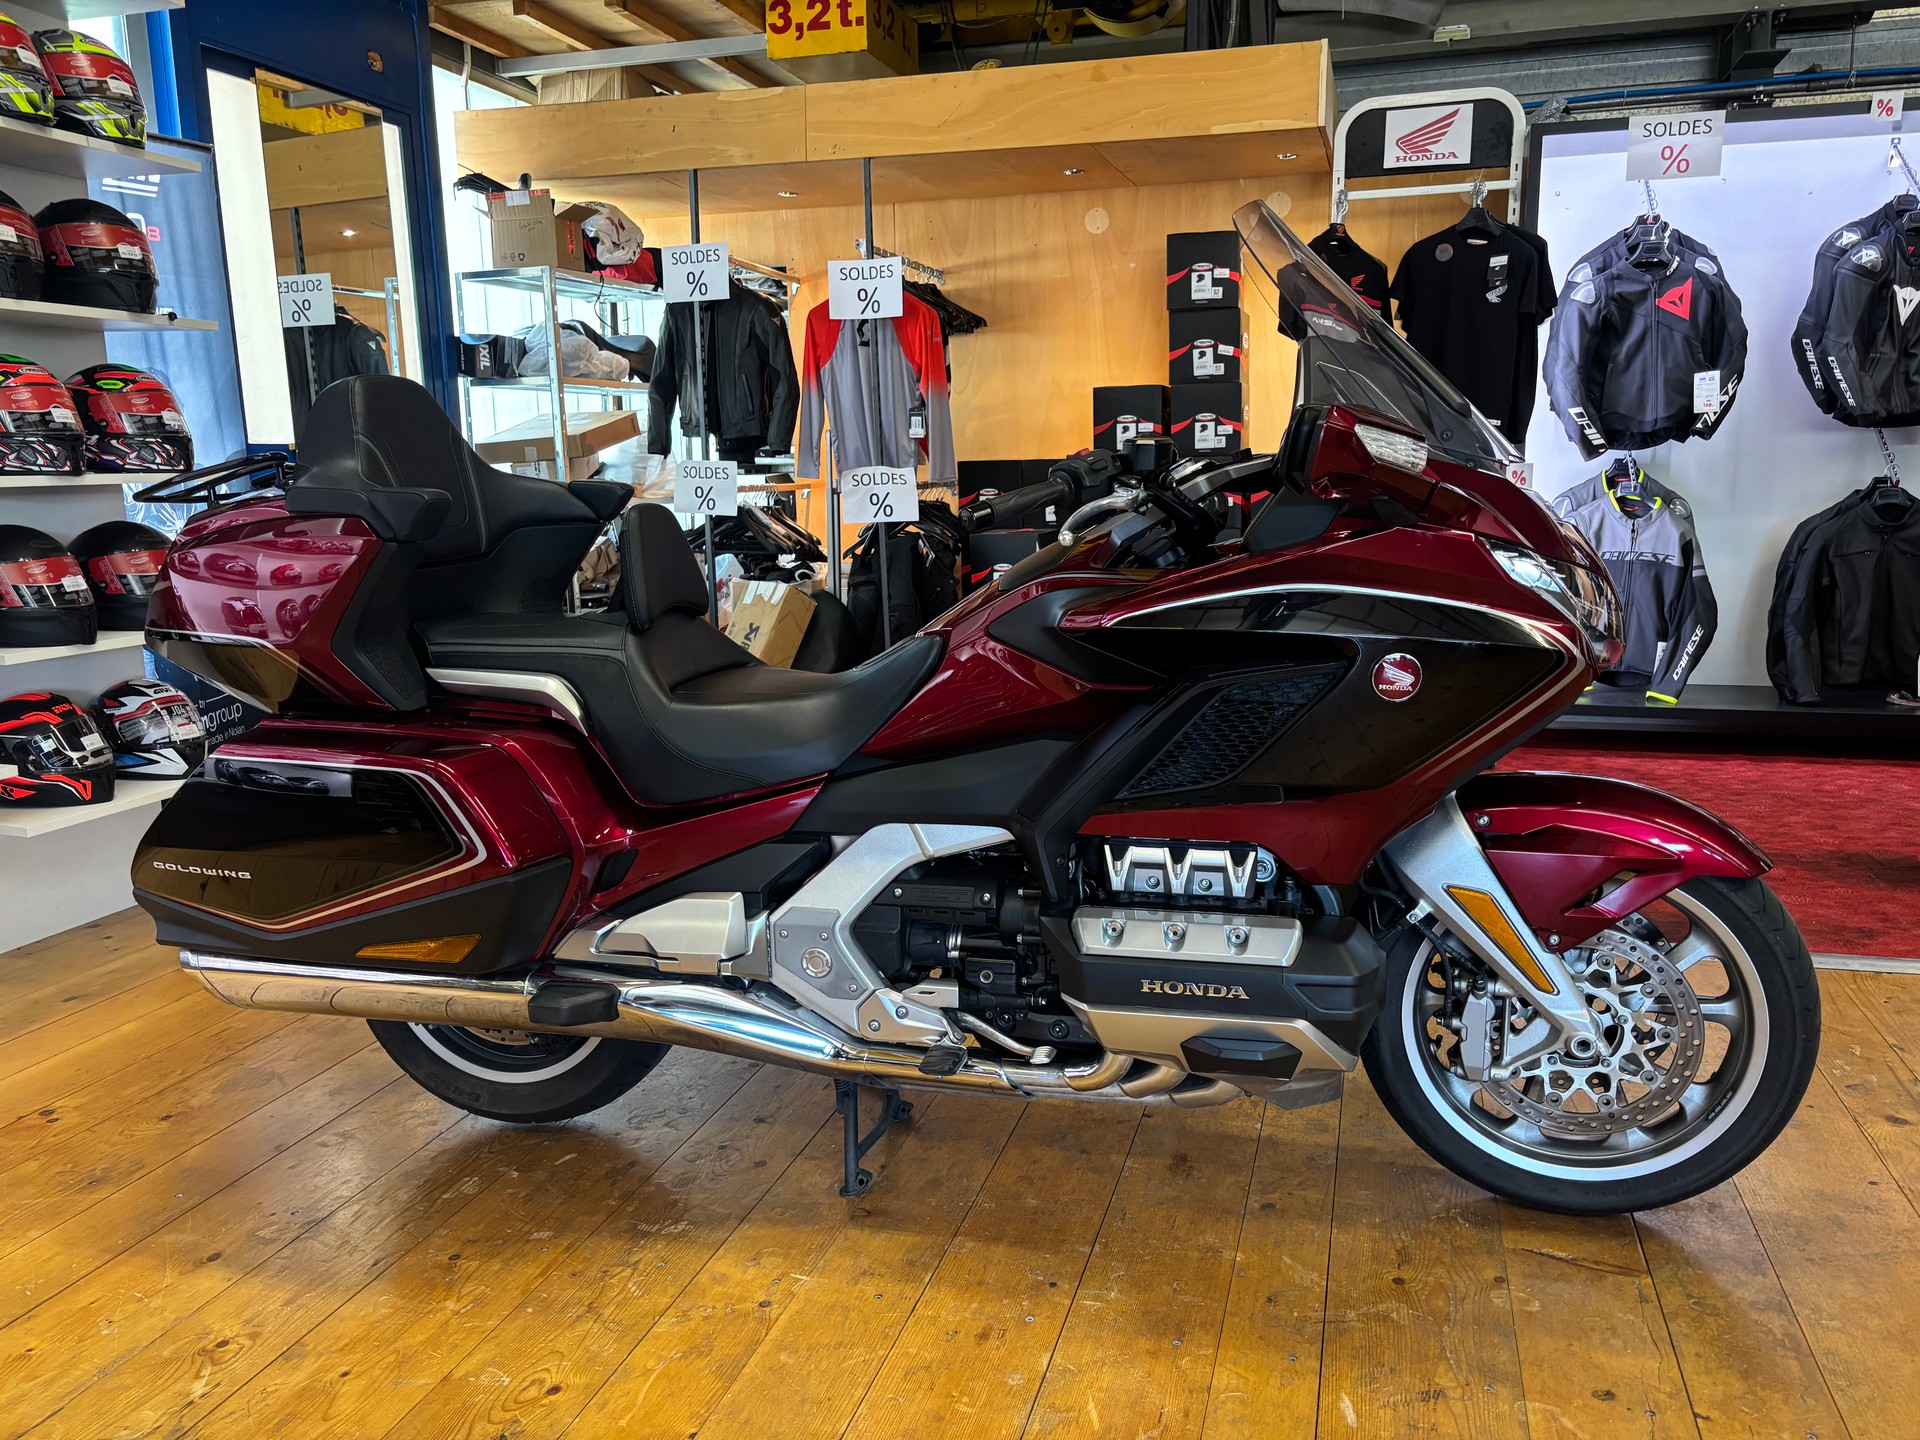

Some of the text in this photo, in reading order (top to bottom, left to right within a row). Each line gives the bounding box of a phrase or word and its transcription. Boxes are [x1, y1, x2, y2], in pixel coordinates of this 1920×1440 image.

[768, 0, 864, 40] 3,2 t.
[1877, 98, 1894, 117] %
[1643, 119, 1713, 138] SOLDES
[1394, 152, 1459, 163] HONDA
[1661, 144, 1690, 175] %
[671, 248, 720, 265] SOLDES
[839, 264, 893, 281] SOLDES
[686, 270, 708, 297] %
[857, 287, 880, 315] %
[1802, 338, 1824, 390] DAINESE
[1828, 356, 1856, 407] DAINESE
[683, 466, 729, 480] SOLDES
[851, 473, 907, 487] SOLDES
[1511, 470, 1527, 486] %
[694, 486, 716, 511] %
[870, 492, 893, 518] %
[1600, 551, 1676, 565] DAINESE
[1673, 625, 1704, 681] DAINESE
[199, 700, 205, 709] by
[229, 725, 245, 738] Nolan
[153, 861, 252, 879] GOLDWING
[1140, 979, 1250, 1000] HONDA
